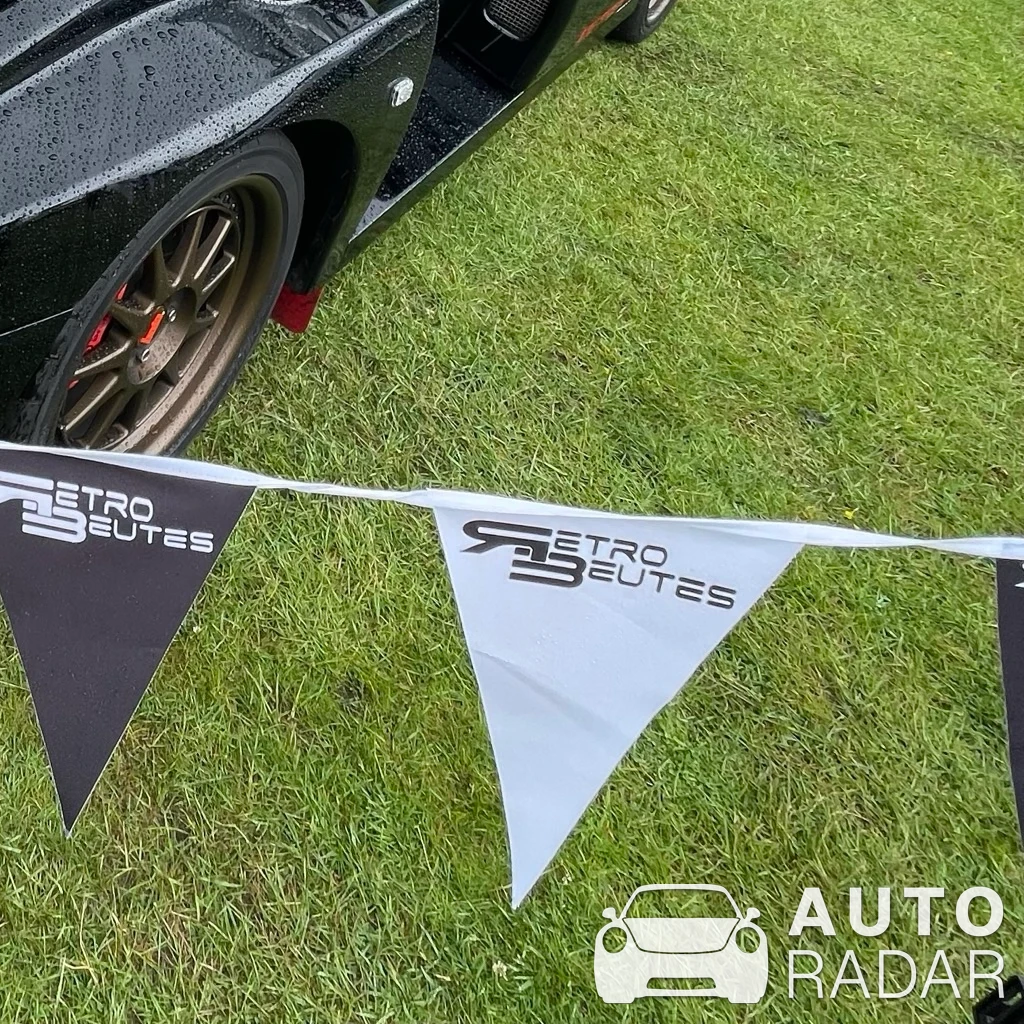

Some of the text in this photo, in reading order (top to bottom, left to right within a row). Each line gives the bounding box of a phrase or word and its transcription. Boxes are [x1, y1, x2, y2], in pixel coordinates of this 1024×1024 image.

[21, 499, 214, 553] BEUTES
[460, 519, 668, 567] RETRO
[508, 547, 737, 609] BEUTES
